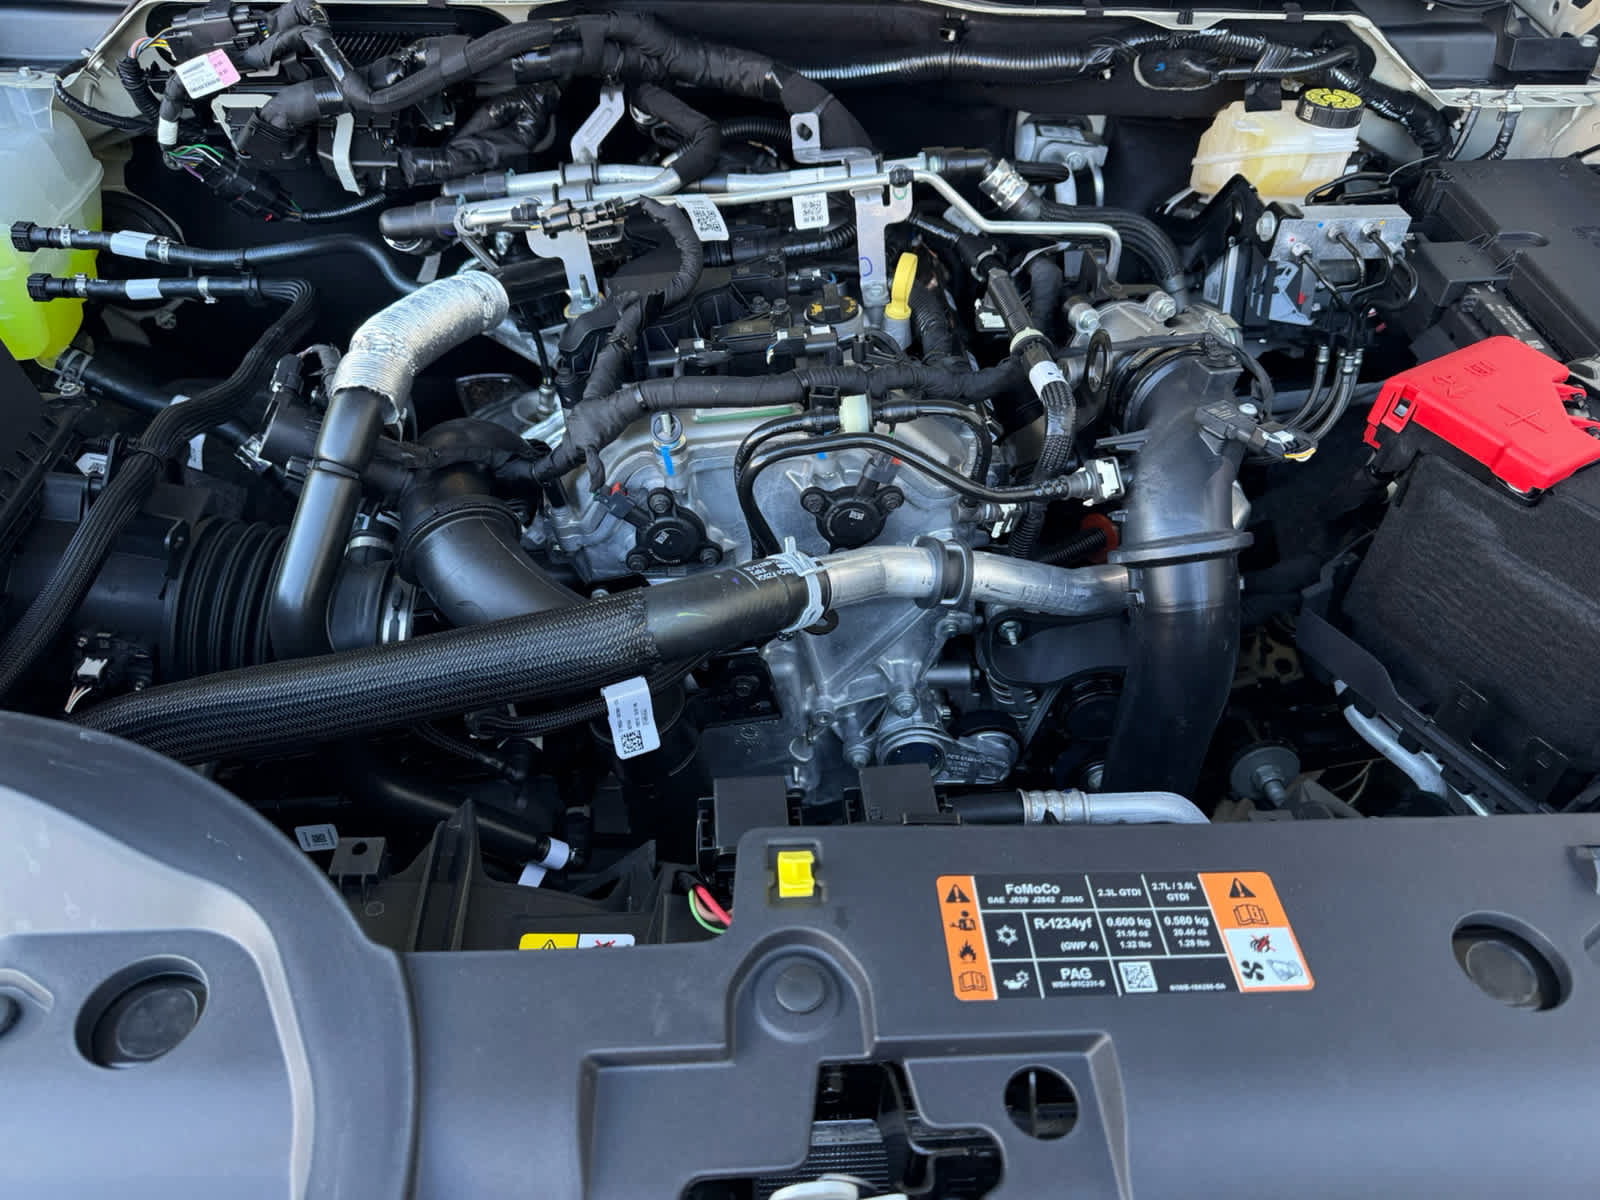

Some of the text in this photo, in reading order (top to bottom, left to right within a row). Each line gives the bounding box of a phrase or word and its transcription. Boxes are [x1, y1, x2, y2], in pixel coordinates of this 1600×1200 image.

[1005, 883, 1061, 895] FoMoCo
[1151, 882, 1172, 891] 2.7L
[1097, 888, 1142, 897] 2.3L GTDI
[1166, 893, 1190, 902] GTDI
[1033, 916, 1092, 932] R-1234yf
[1105, 916, 1152, 929] 0.600 kg
[1163, 915, 1209, 928] 0.580 kg
[1060, 941, 1099, 952] (GWP 4)
[1138, 940, 1152, 949] lbs
[1060, 967, 1092, 980] PAG
